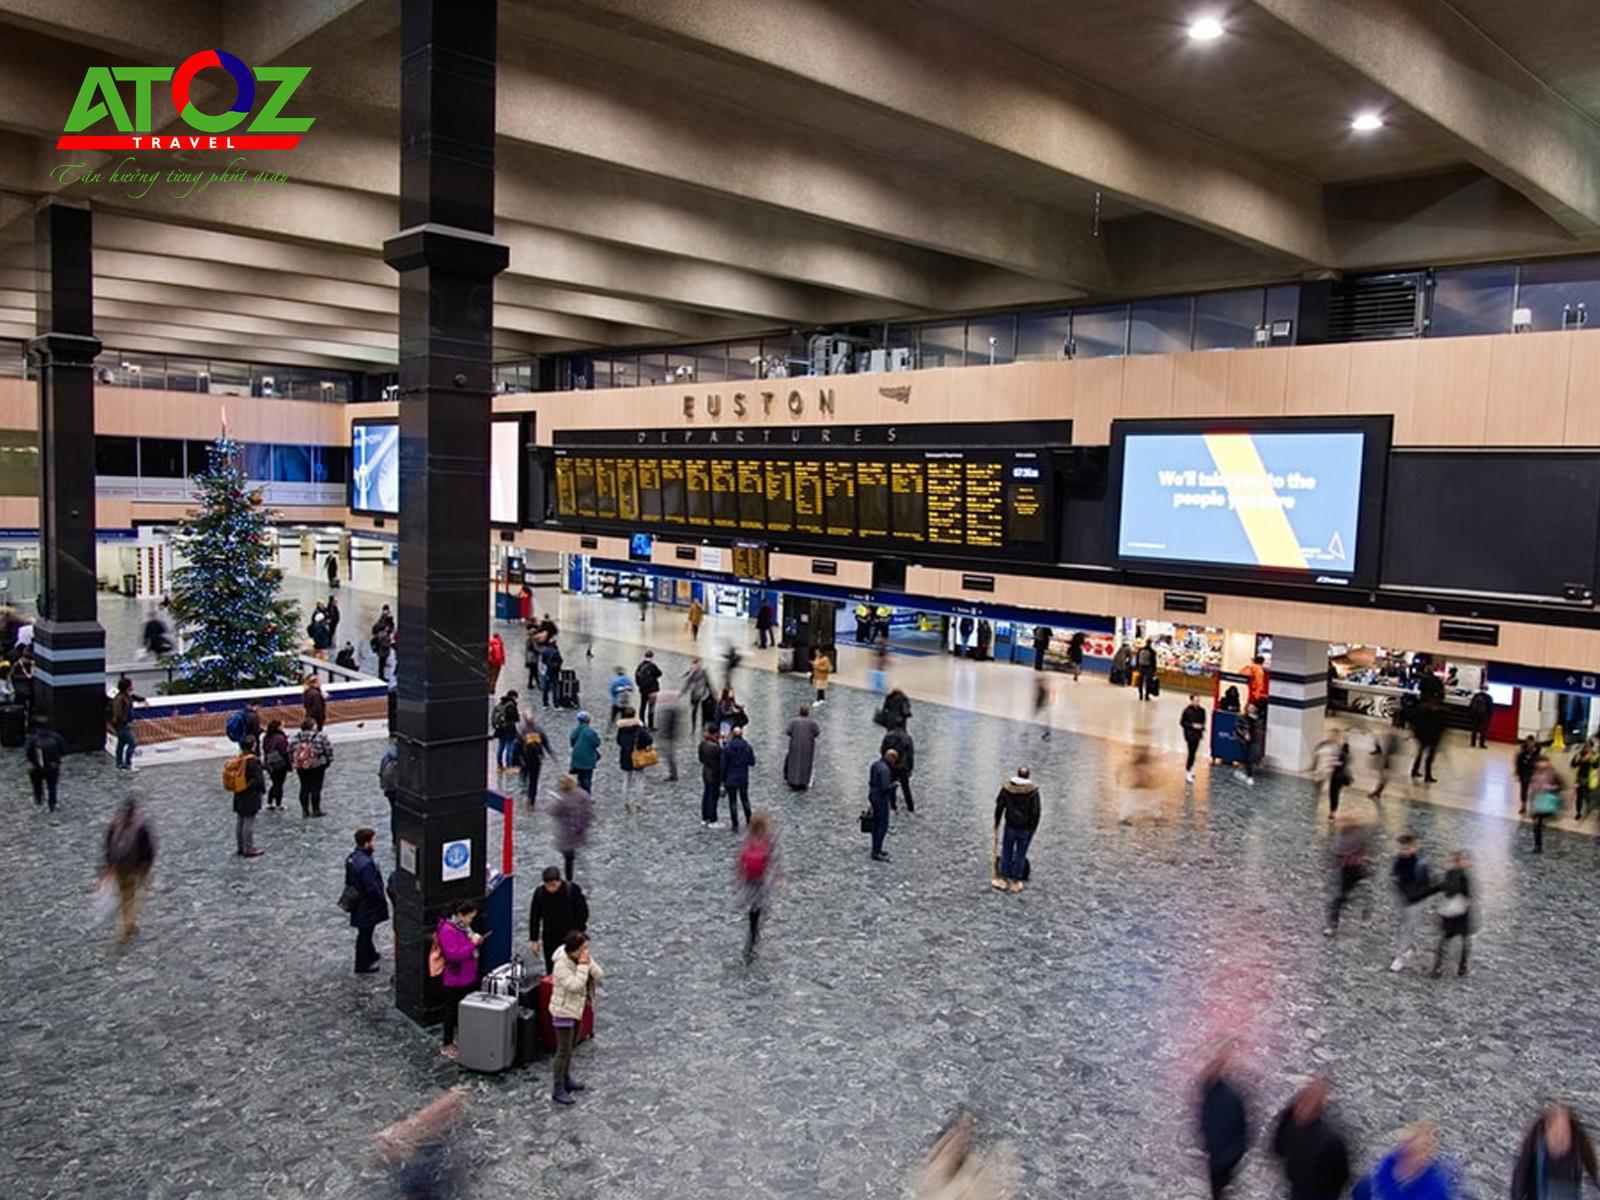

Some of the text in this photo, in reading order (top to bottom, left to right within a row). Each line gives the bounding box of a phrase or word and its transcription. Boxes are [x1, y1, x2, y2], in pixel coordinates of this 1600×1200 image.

[682, 388, 836, 419] EUSTON
[636, 428, 898, 443] DEPARTURES
[1158, 470, 1197, 487] We'll
[1287, 471, 1317, 490] the
[1173, 490, 1226, 509] people
